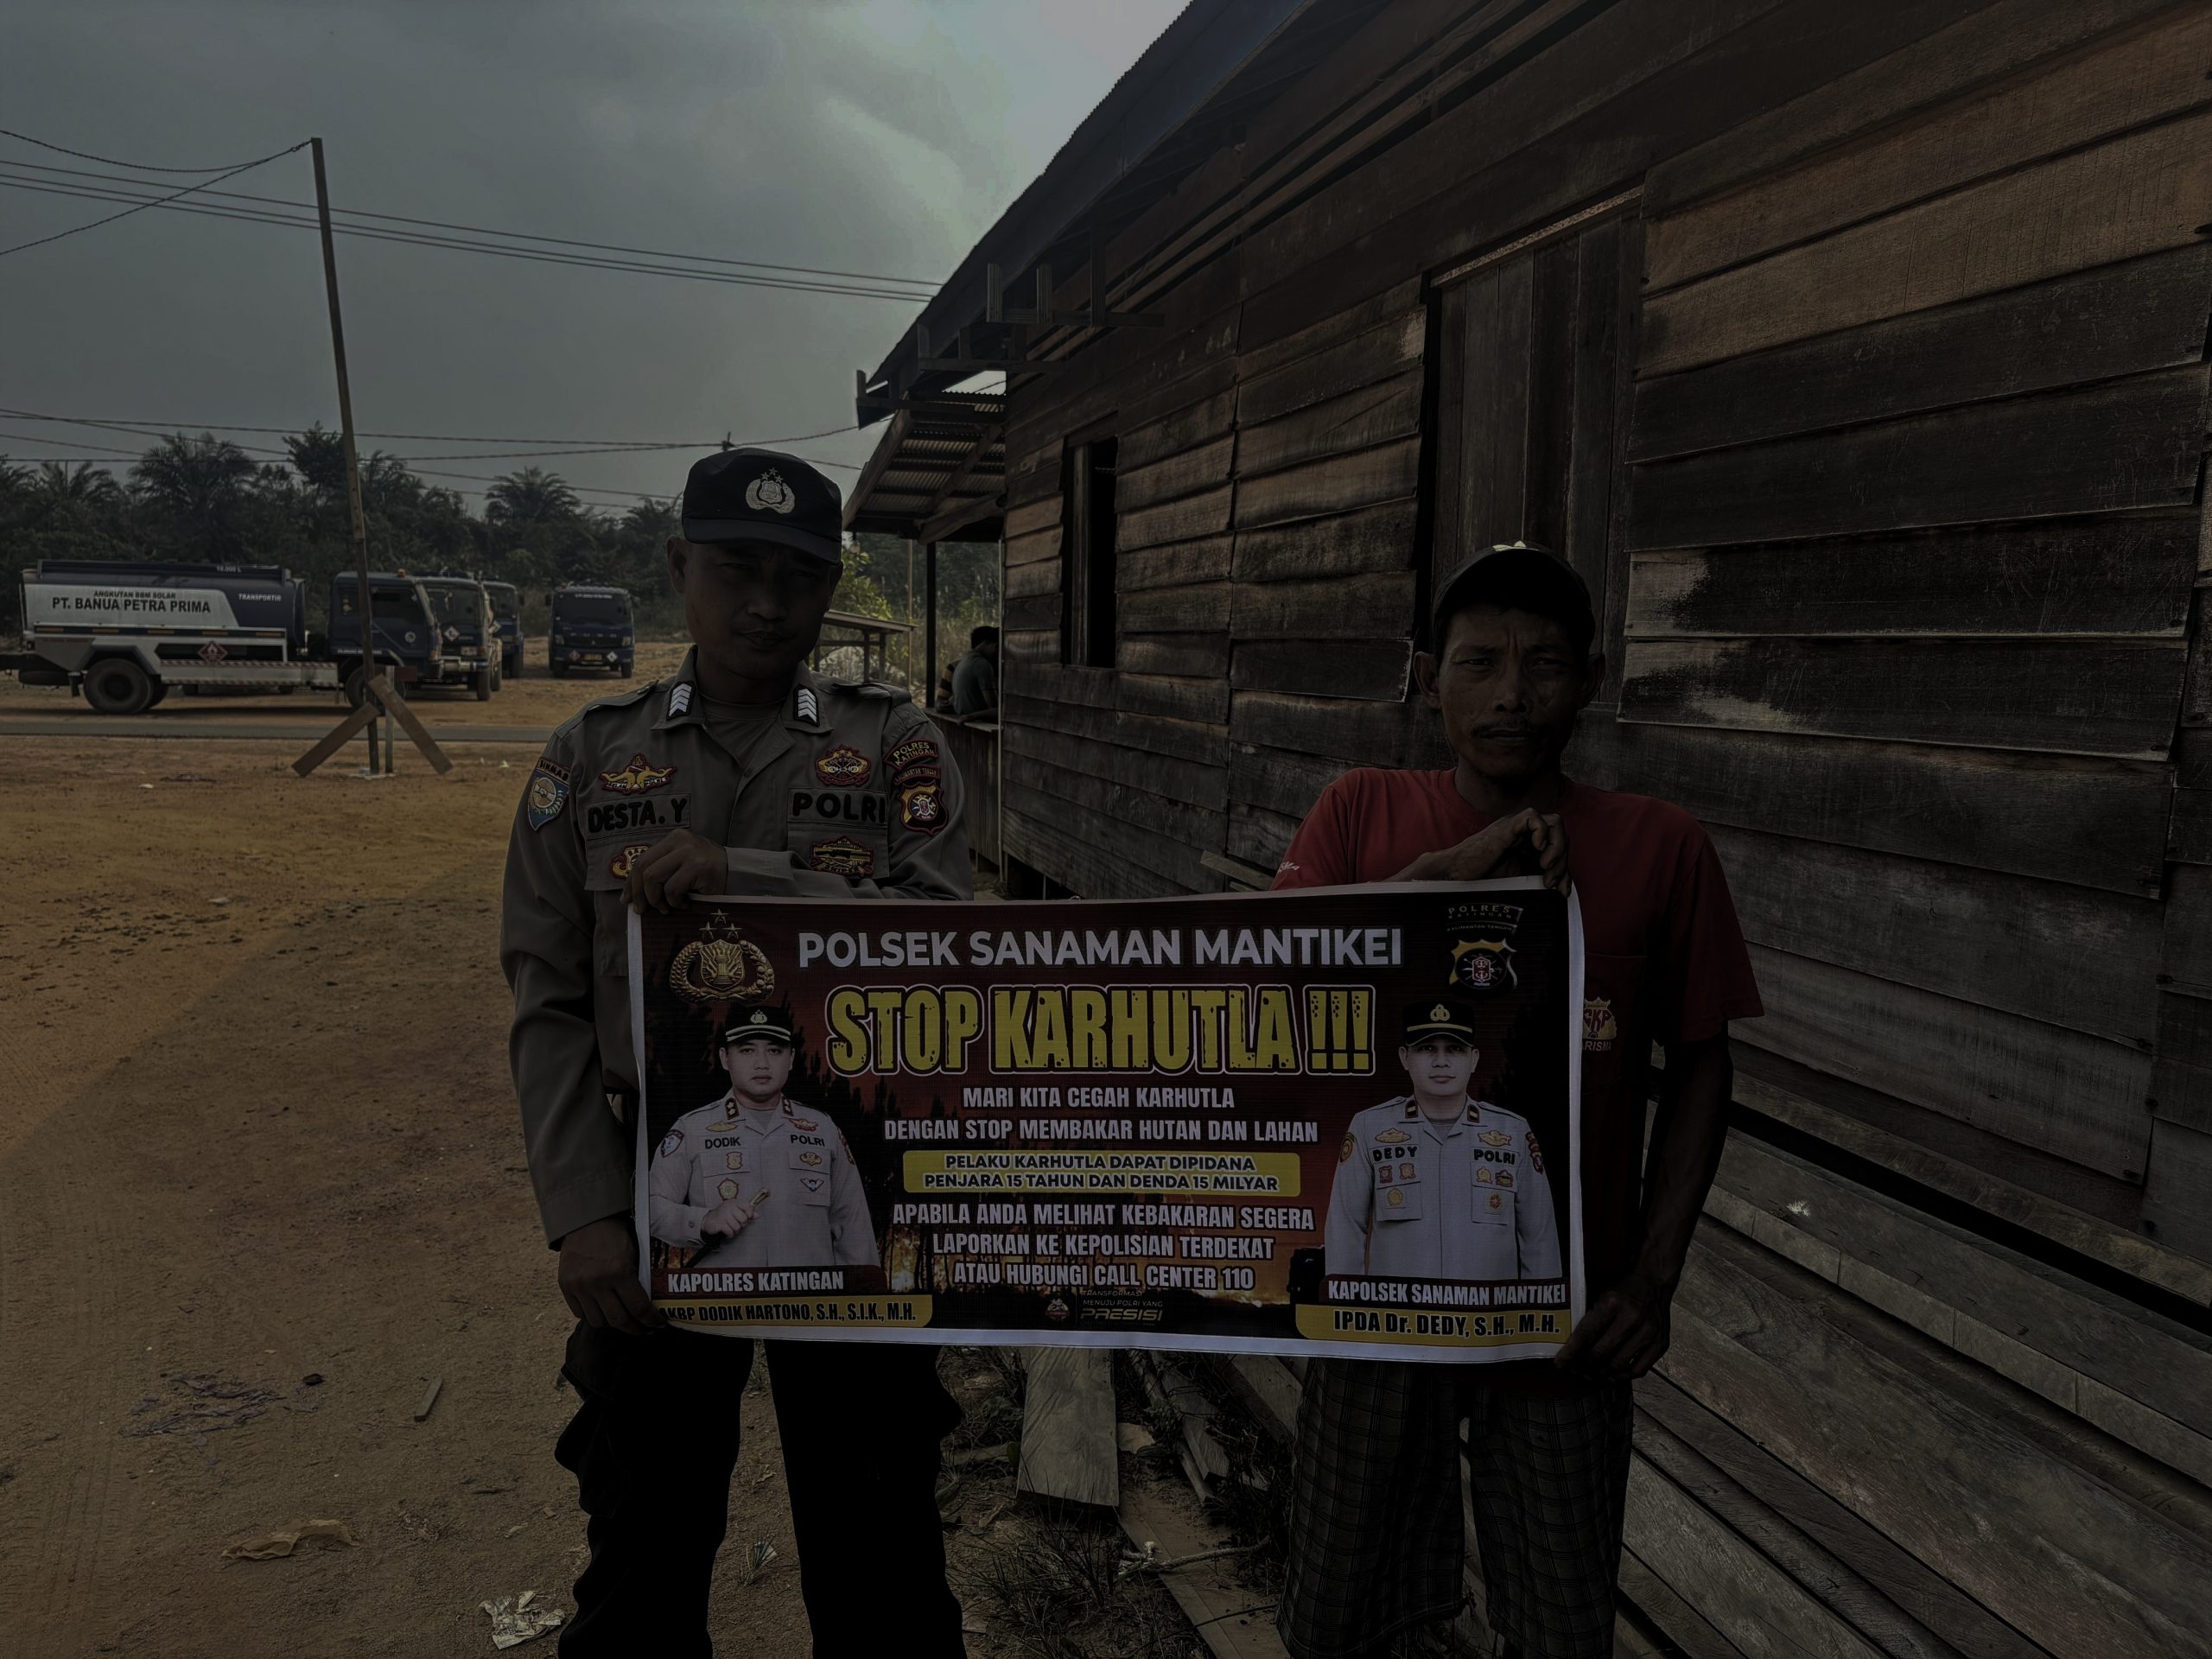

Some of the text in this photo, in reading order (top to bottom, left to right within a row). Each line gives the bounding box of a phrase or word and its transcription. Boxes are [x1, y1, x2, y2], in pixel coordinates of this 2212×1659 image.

[52, 597, 211, 613] PT. BANUA PETRA PRIMA
[893, 741, 931, 759] POLRES
[792, 792, 886, 823] POLRI
[1447, 905, 1511, 915] POLRES
[798, 927, 1402, 969] POLSEK SANAMAN MANTIKEI
[827, 985, 1376, 1076] STOP KARHUTLA !!!
[963, 1087, 1236, 1109] MARI KITA CEGAH KARHUTLA
[791, 1135, 825, 1147] POLRI
[884, 1120, 1319, 1143] DENGAN STOP MEMBAKAR HUTAN DAN LAHAN
[705, 1137, 741, 1149] DODIK
[946, 1155, 1255, 1171] PELAKU KARHUTLA DAPAT DIPIDANA
[1372, 1146, 1418, 1162] DEDY
[1474, 1148, 1516, 1165] POLRI
[925, 1174, 1279, 1191] PENJARA 15 TAHUN DAN DENDA 15 MILYAR
[893, 1204, 1316, 1231] APABILA ANDA MELIHAT KEBAKARAN SEGERA
[932, 1233, 1275, 1260] LAPORKAN KE KEPOLISIAN TERDEKAT
[667, 1271, 844, 1293] KAPOLRES KATINGAN
[954, 1262, 1255, 1290] ATAU HUBUNGI CALL CENTER 110
[1328, 1281, 1567, 1306] KAPOLSEK SANAMAN MANTIKEI
[698, 1306, 743, 1321] DODIK
[746, 1303, 814, 1322] HARTONO,
[816, 1303, 845, 1322] S.H.,
[848, 1302, 885, 1321] S.I.K.,
[887, 1302, 916, 1320] M.H.
[1080, 1307, 1164, 1322] PRESISI
[1334, 1310, 1561, 1338] IPDA Dr. DEDY, S.H., M.H.
